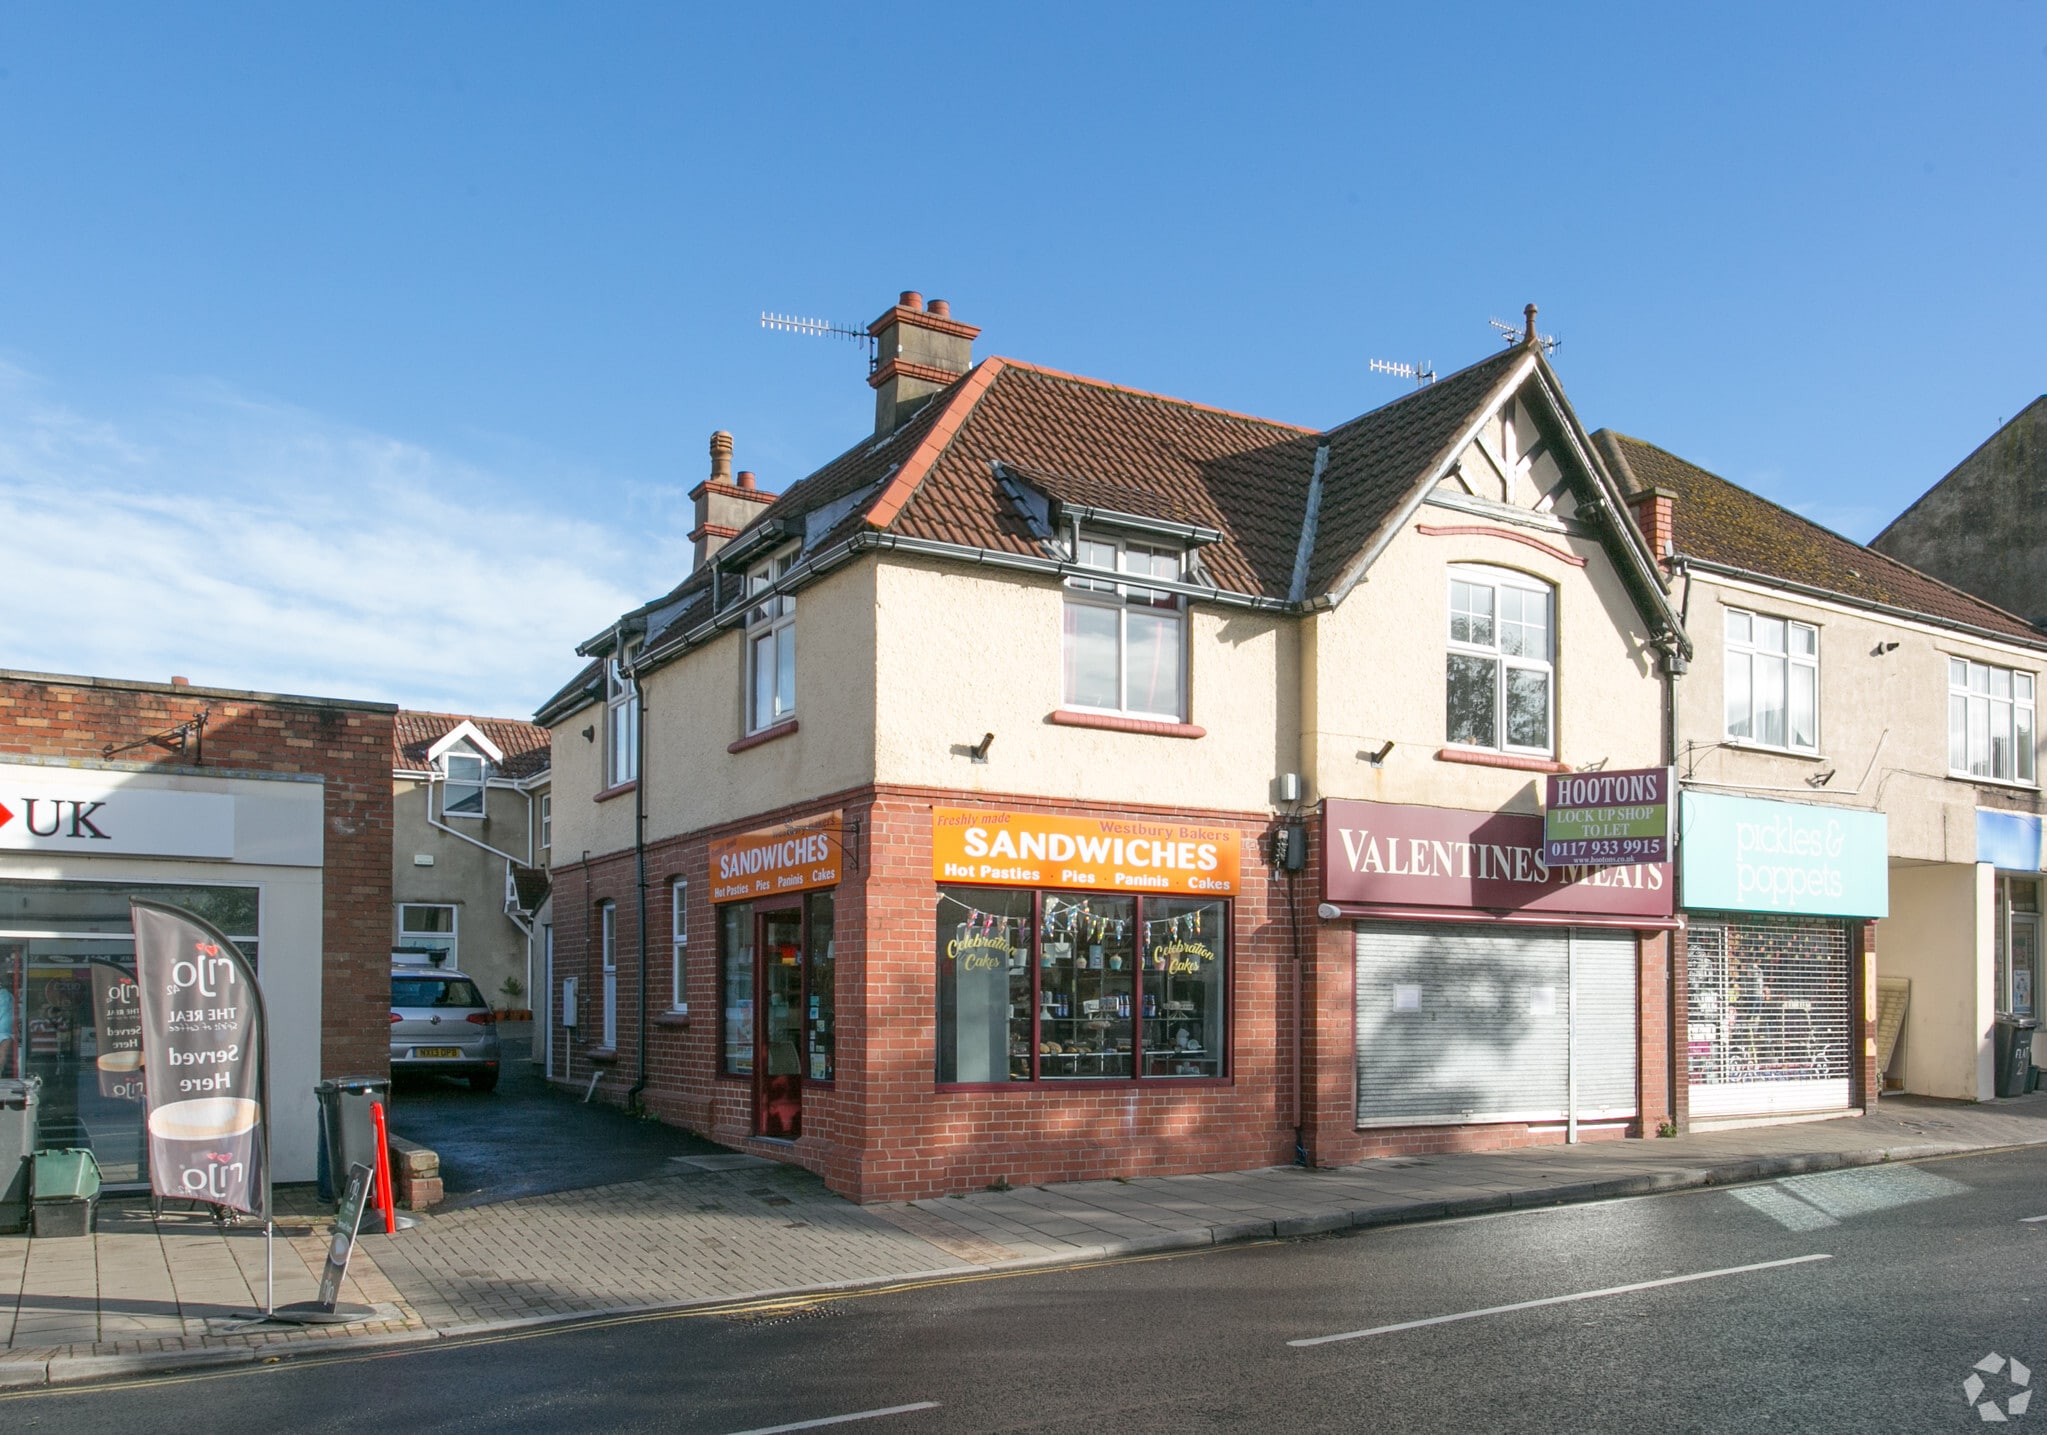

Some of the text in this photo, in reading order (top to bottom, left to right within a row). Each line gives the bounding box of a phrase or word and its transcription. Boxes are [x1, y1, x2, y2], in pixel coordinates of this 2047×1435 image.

[1556, 775, 1657, 807] HOOTONS
[21, 798, 112, 840] UK
[937, 812, 1011, 828] Freshly made
[1557, 807, 1655, 823] LOCK UP SHOP
[1100, 821, 1230, 842] Westbury Bakers
[1582, 823, 1630, 837] TO LET
[1736, 814, 1846, 862] pickles &
[720, 832, 829, 880] SANDWICHES
[964, 827, 1218, 871] SANDWICHES
[1339, 829, 1549, 884] VALENTINES
[1552, 839, 1660, 857] 0117 933 9915
[1573, 855, 1636, 864] www.hootons.co.uk
[714, 867, 836, 898] Hot Pasties Pies Paninis Cakes
[944, 863, 1231, 890] Hot Pasties Pies Paninis Cakes
[1736, 861, 1843, 906] poppets
[946, 933, 1017, 959] Celebration
[1153, 939, 1216, 963] Celebration
[964, 953, 999, 971] Cakes
[1168, 957, 1200, 975] Cakes
[2016, 1060, 2024, 1076] 2
